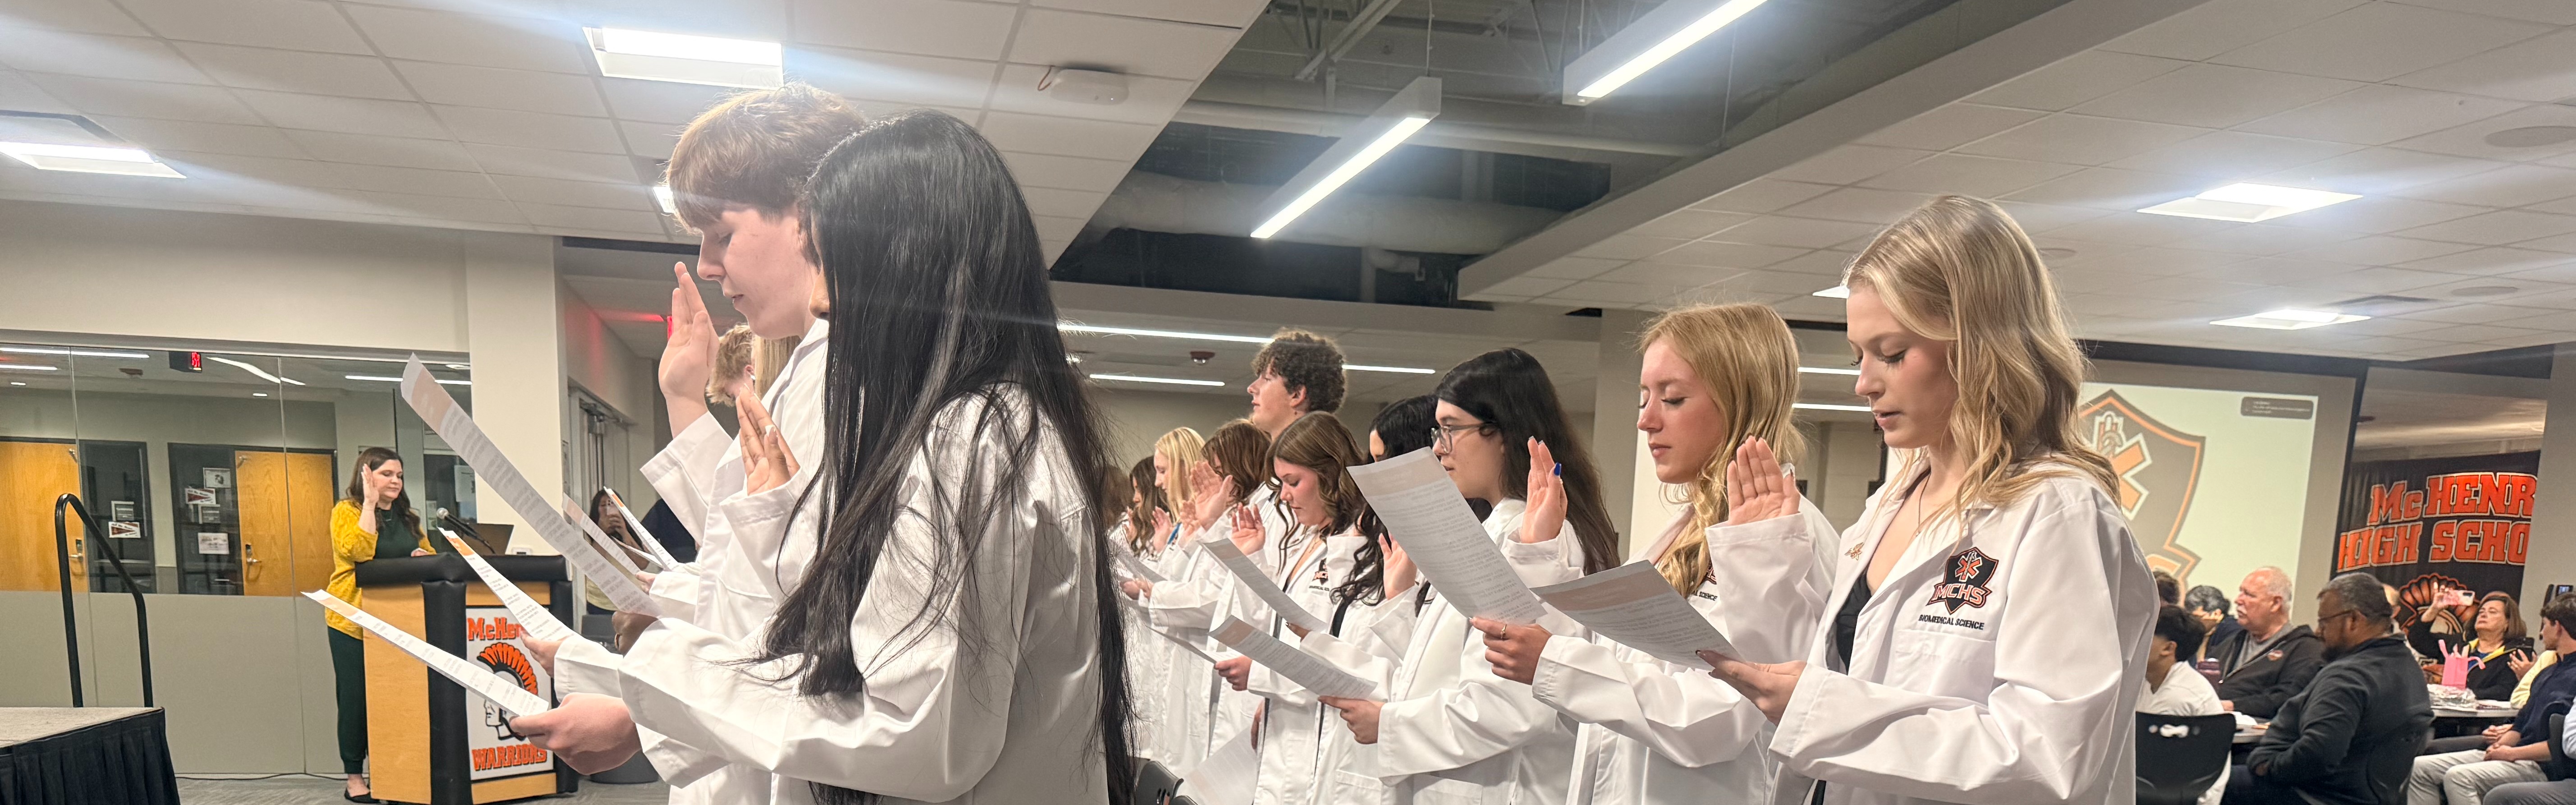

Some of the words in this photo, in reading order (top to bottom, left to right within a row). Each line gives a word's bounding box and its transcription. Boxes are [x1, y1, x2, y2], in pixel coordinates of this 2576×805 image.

[2336, 521, 2423, 572] HIGH
[1932, 583, 1985, 604] MCHS
[1918, 614, 1954, 625] BIOMEDICAL
[1955, 618, 1985, 630] SCIENCE
[472, 744, 547, 771] WARRIORS
